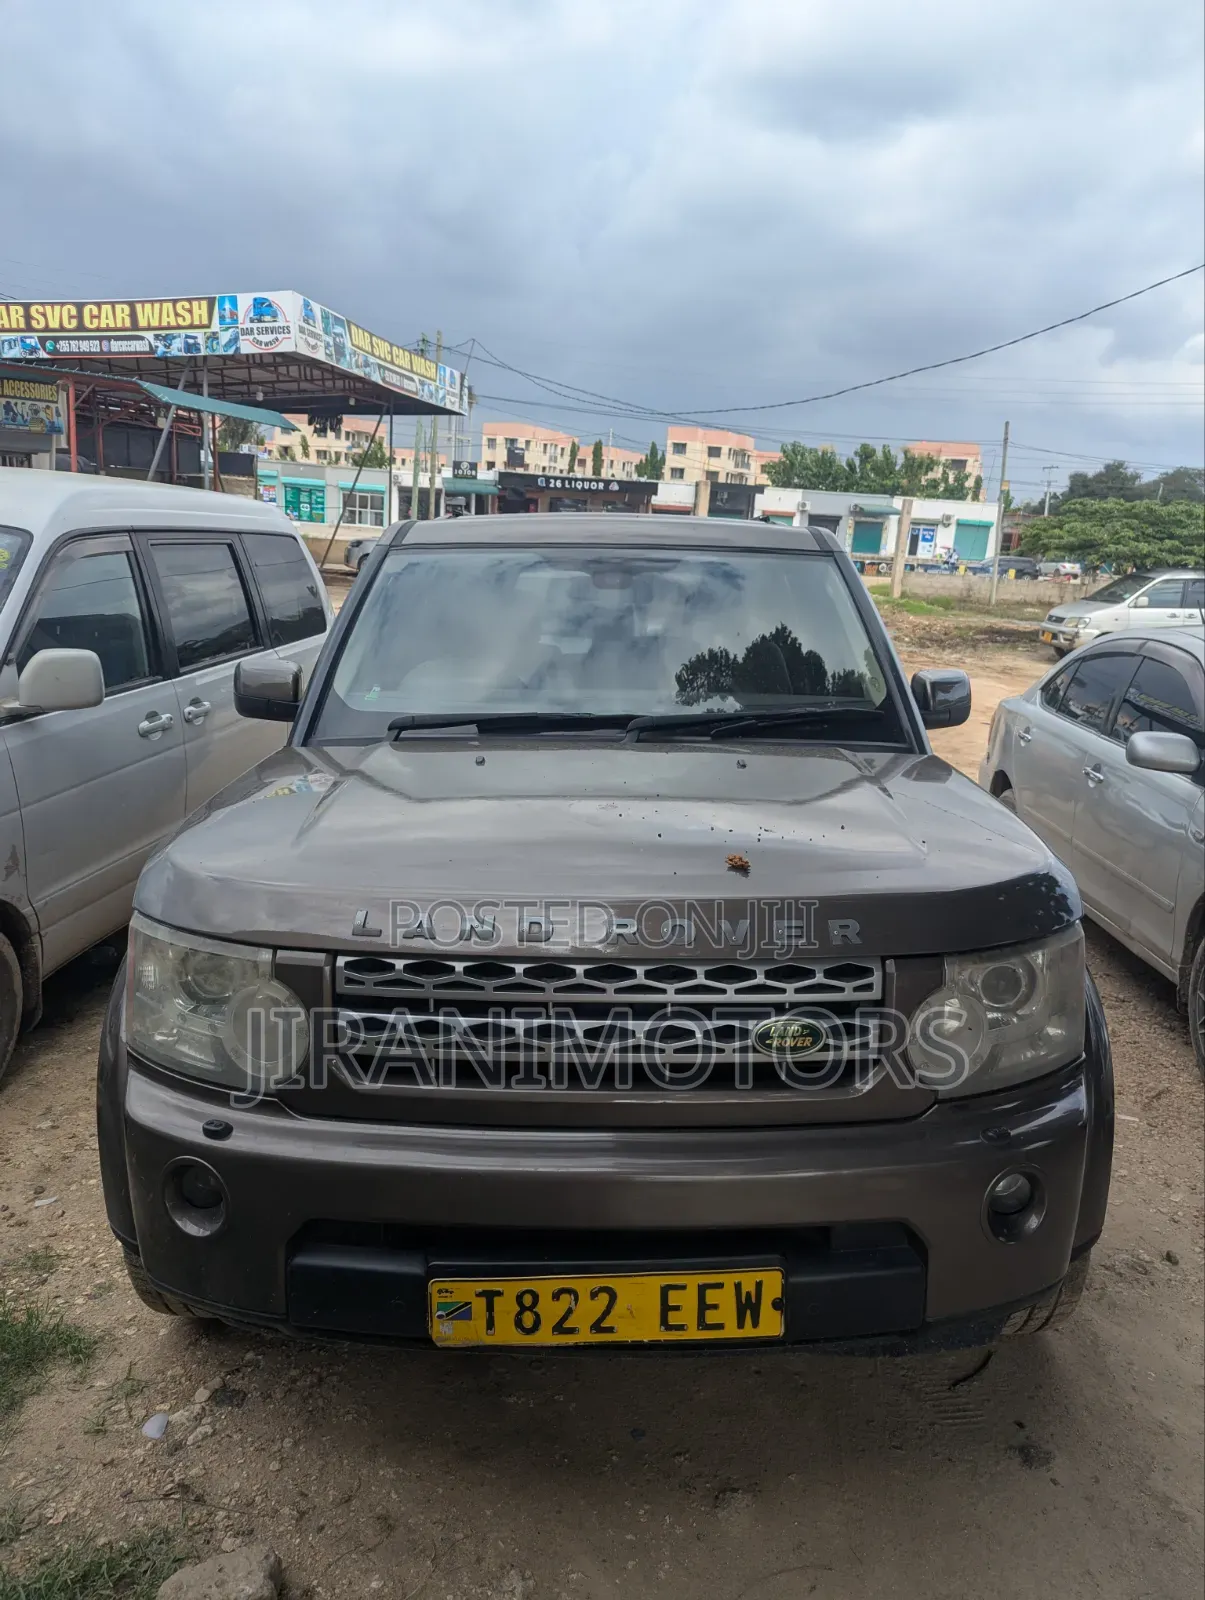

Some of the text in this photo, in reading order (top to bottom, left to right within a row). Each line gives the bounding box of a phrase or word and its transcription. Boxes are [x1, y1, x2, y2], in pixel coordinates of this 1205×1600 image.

[30, 303, 77, 329] SVC
[83, 303, 131, 329] CAR
[135, 299, 209, 328] WASH
[240, 325, 291, 337] DAR SERVICES
[252, 336, 280, 348] CAR WASH
[350, 322, 372, 354] DAR
[372, 336, 392, 362] SVC
[392, 345, 411, 371] CAR
[411, 352, 437, 381] WASH
[3, 379, 57, 402] ACCESSORIES
[549, 479, 605, 490] 26 LIQUOR
[352, 910, 862, 946] LAND ROVER
[770, 1025, 802, 1036] LAND
[773, 1037, 812, 1047] ROVER
[475, 1279, 763, 1336] T822 EEW
